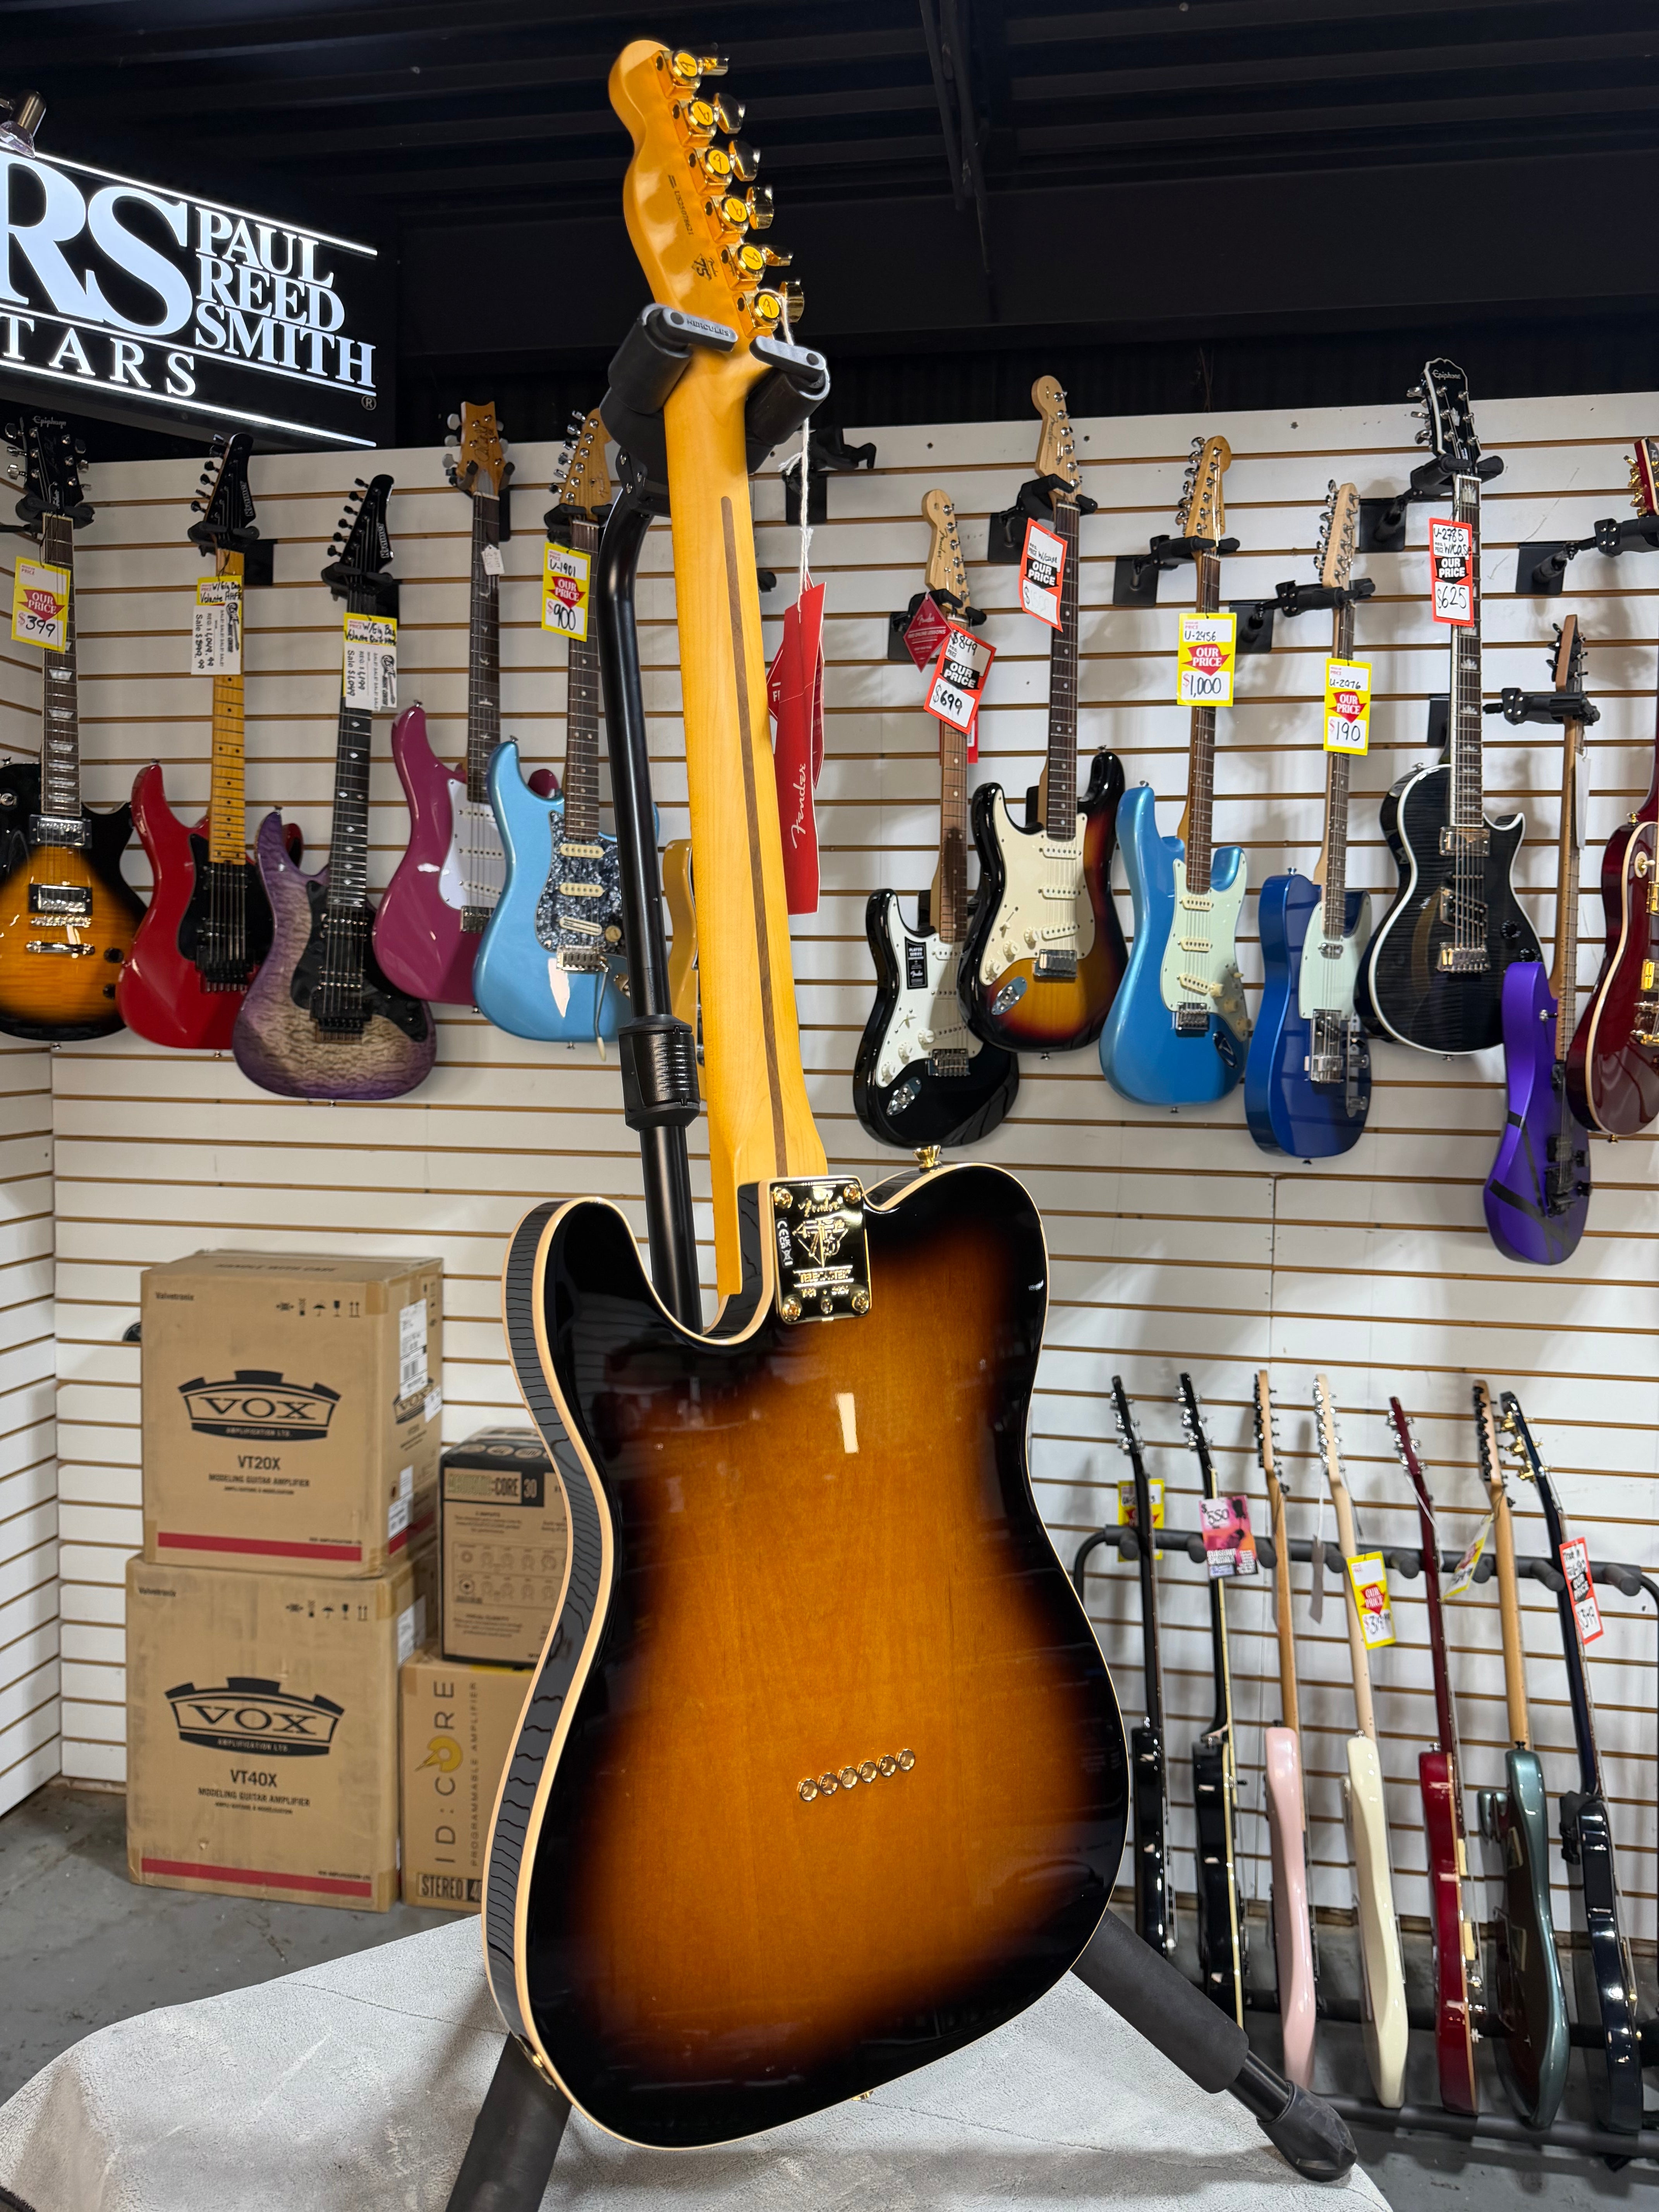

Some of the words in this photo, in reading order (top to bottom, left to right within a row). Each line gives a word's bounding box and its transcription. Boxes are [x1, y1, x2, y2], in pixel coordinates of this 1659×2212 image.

[196, 207, 333, 288] PAUL
[196, 254, 345, 332] REED
[687, 318, 730, 336] HERCULES
[195, 302, 376, 388] SMITH
[1432, 369, 1462, 380] Epiphone
[939, 528, 948, 560] Fender
[1032, 561, 1052, 575] OUR
[1441, 558, 1460, 568] OUR
[1027, 569, 1056, 586] PRICE
[1439, 567, 1465, 578] PRICE
[555, 587, 579, 602] PRICE
[558, 580, 577, 592] OUR
[32, 592, 53, 605] OUR
[1437, 586, 1467, 609] $625
[28, 600, 57, 614] PRICE
[195, 614, 203, 631] Sale
[1185, 630, 1216, 642] U-2456
[1196, 647, 1219, 658] OUR
[950, 663, 973, 678] OUR
[1192, 657, 1223, 667] PRICE
[943, 669, 976, 689] PRICE
[933, 684, 963, 716] $699
[1340, 694, 1358, 705] OUR
[1336, 704, 1361, 715] PRICE
[791, 763, 805, 849] Fender
[798, 1197, 840, 1218] Fender
[199, 1396, 316, 1420] VOX
[226, 1427, 275, 1436] AMPLIFICATION
[238, 1454, 281, 1471] VT20X
[208, 1473, 244, 1482] MODELING
[246, 1475, 271, 1484] GUITAR
[273, 1477, 309, 1487] AMPLIFIER
[524, 1478, 538, 1499] 30
[1572, 1574, 1585, 1588] OUR
[1365, 1587, 1381, 1598] OUR
[1573, 1581, 1590, 1601] PRICE
[1365, 1595, 1383, 1608] PRICE
[187, 1704, 317, 1735] VOX
[469, 1681, 479, 1752] AMPLIFIER
[217, 1738, 272, 1751] AMPLIFICATION
[230, 1769, 278, 1788] VT40X
[198, 1787, 237, 1800] MODELING
[239, 1791, 267, 1802] GUITAR
[269, 1795, 310, 1807] AMPLIFIER
[471, 1761, 479, 1867] PROGRAMMABLE
[421, 1875, 464, 1898] STEREO
